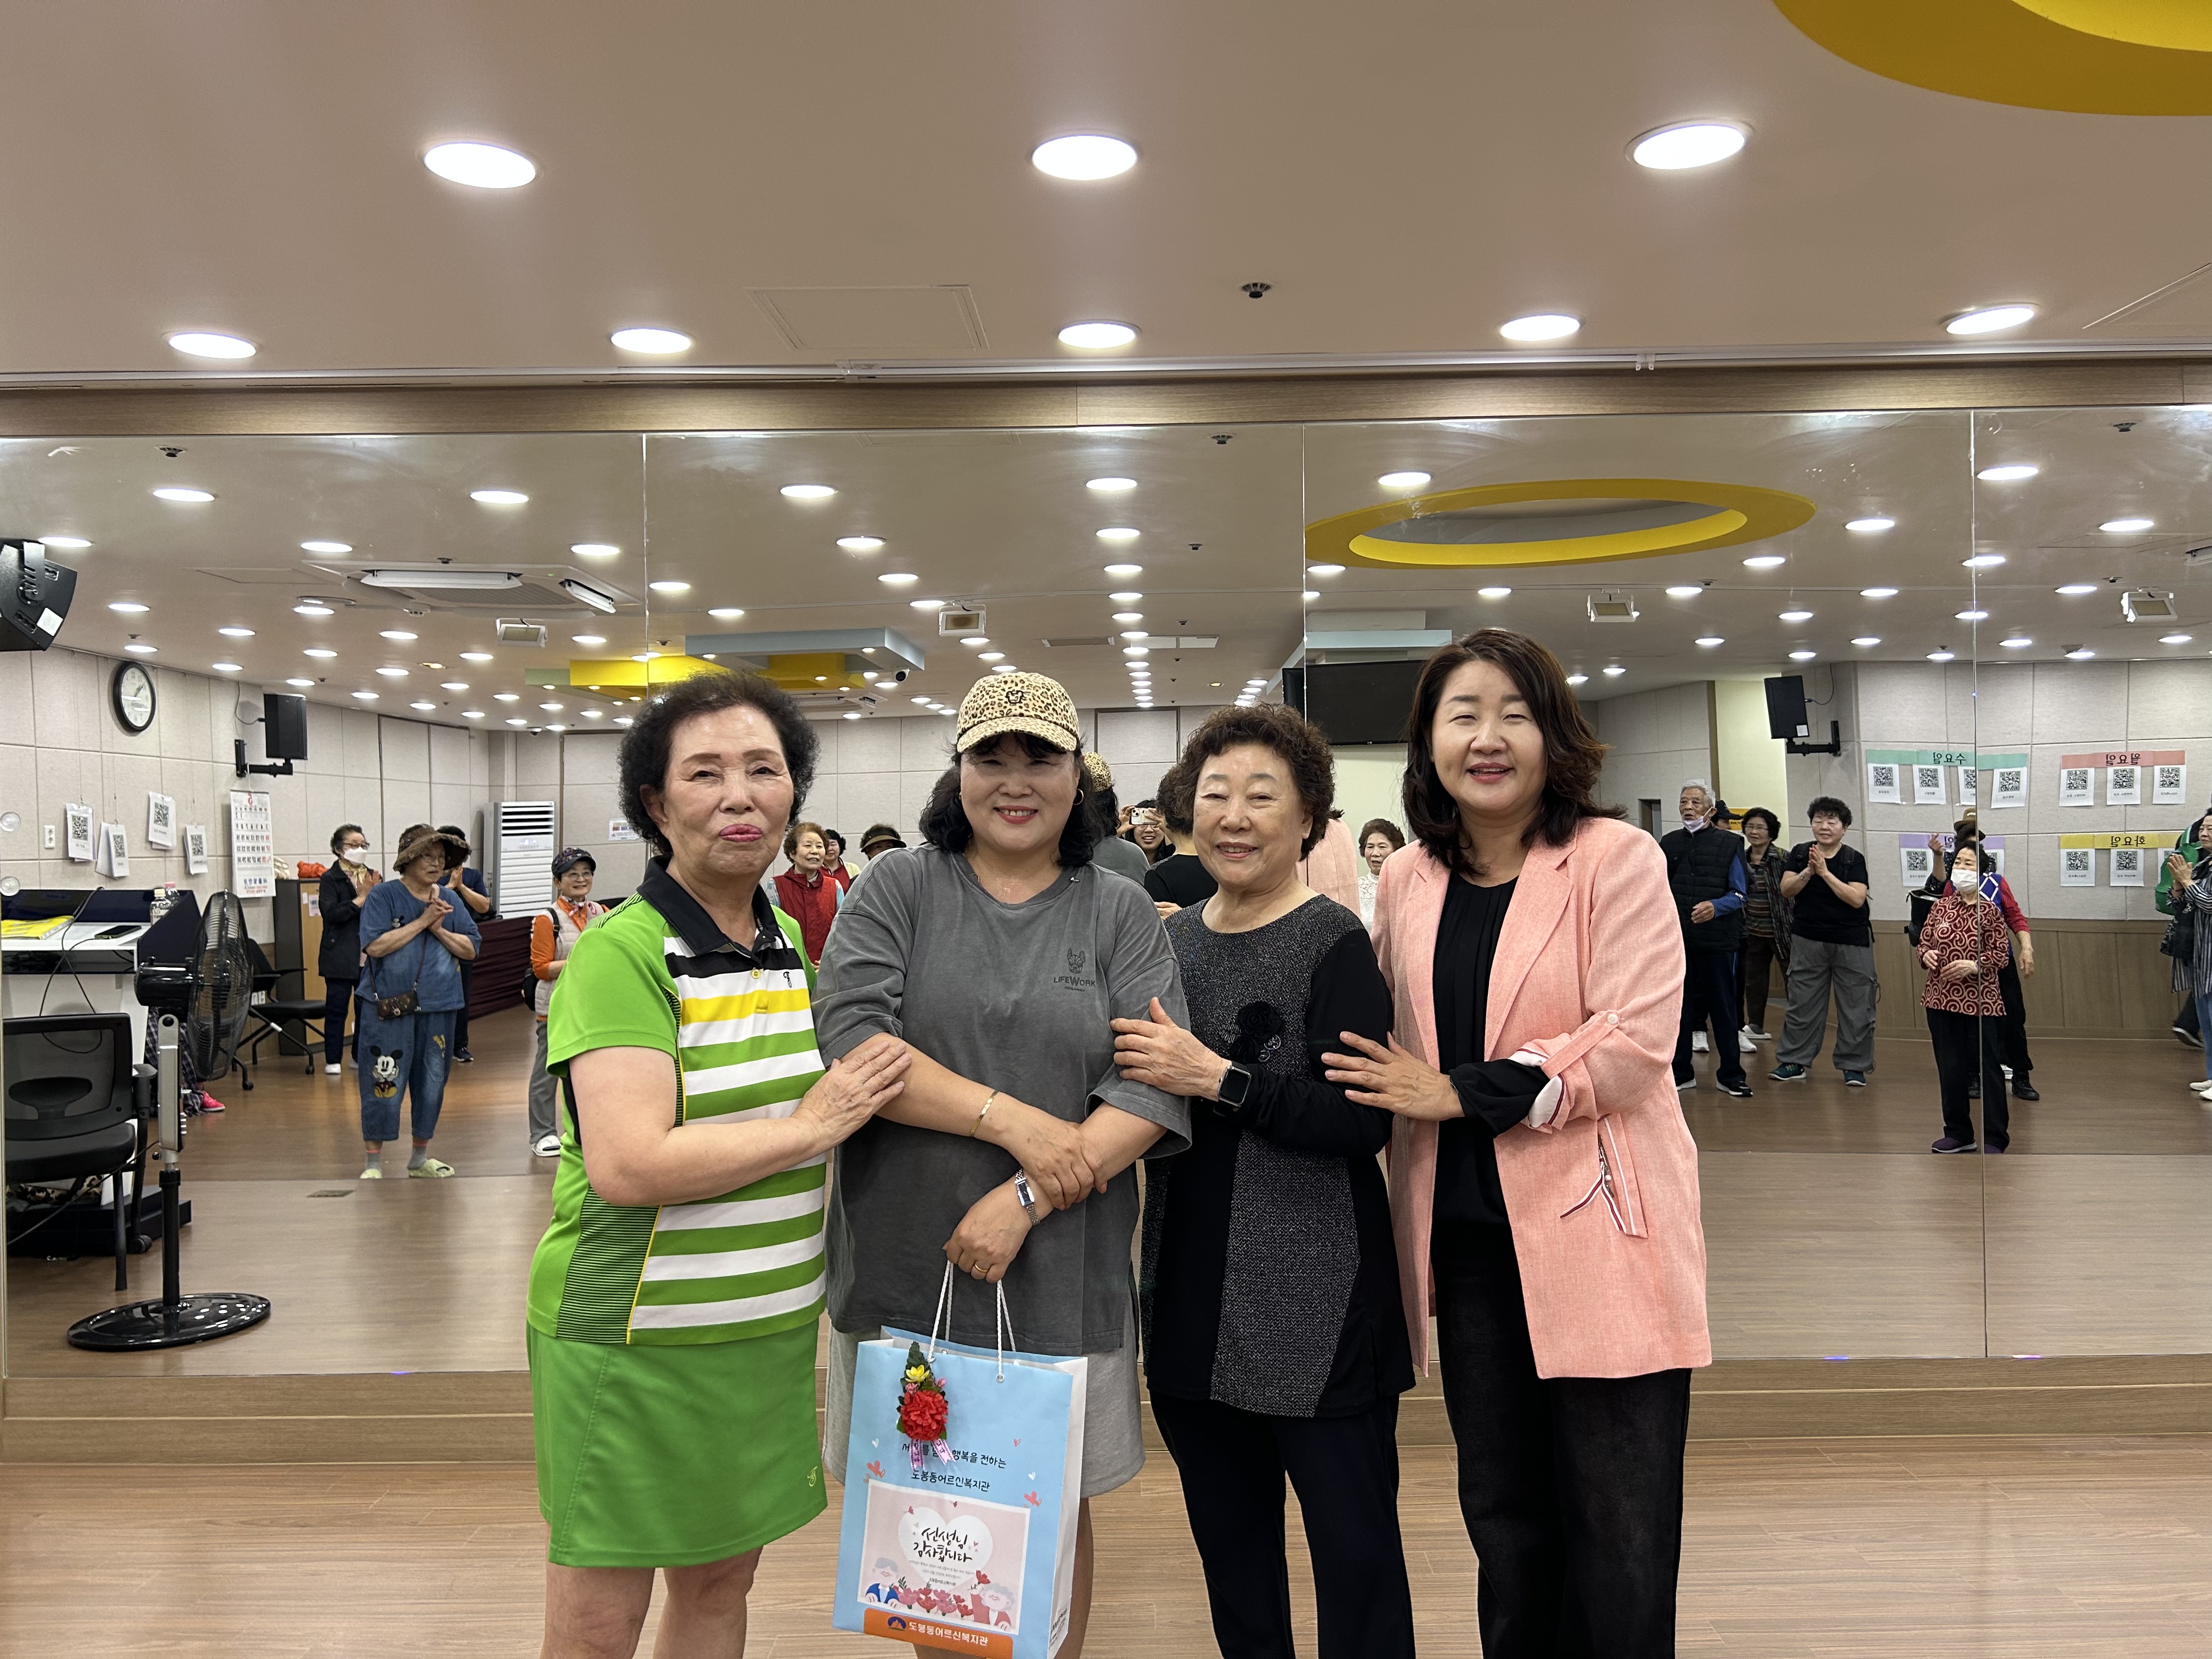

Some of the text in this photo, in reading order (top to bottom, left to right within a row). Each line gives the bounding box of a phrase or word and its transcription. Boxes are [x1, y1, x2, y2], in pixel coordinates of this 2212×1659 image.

[1053, 976, 1096, 988] LIFEWORK
[952, 1449, 978, 1463] 행복을
[980, 1454, 1007, 1469] 전하는
[911, 1469, 990, 1492] 도봉동어르신복지관
[921, 1527, 968, 1549] 선생님
[913, 1540, 973, 1562] 감사합니다
[909, 1621, 988, 1646] 도봉동어르신복지관
